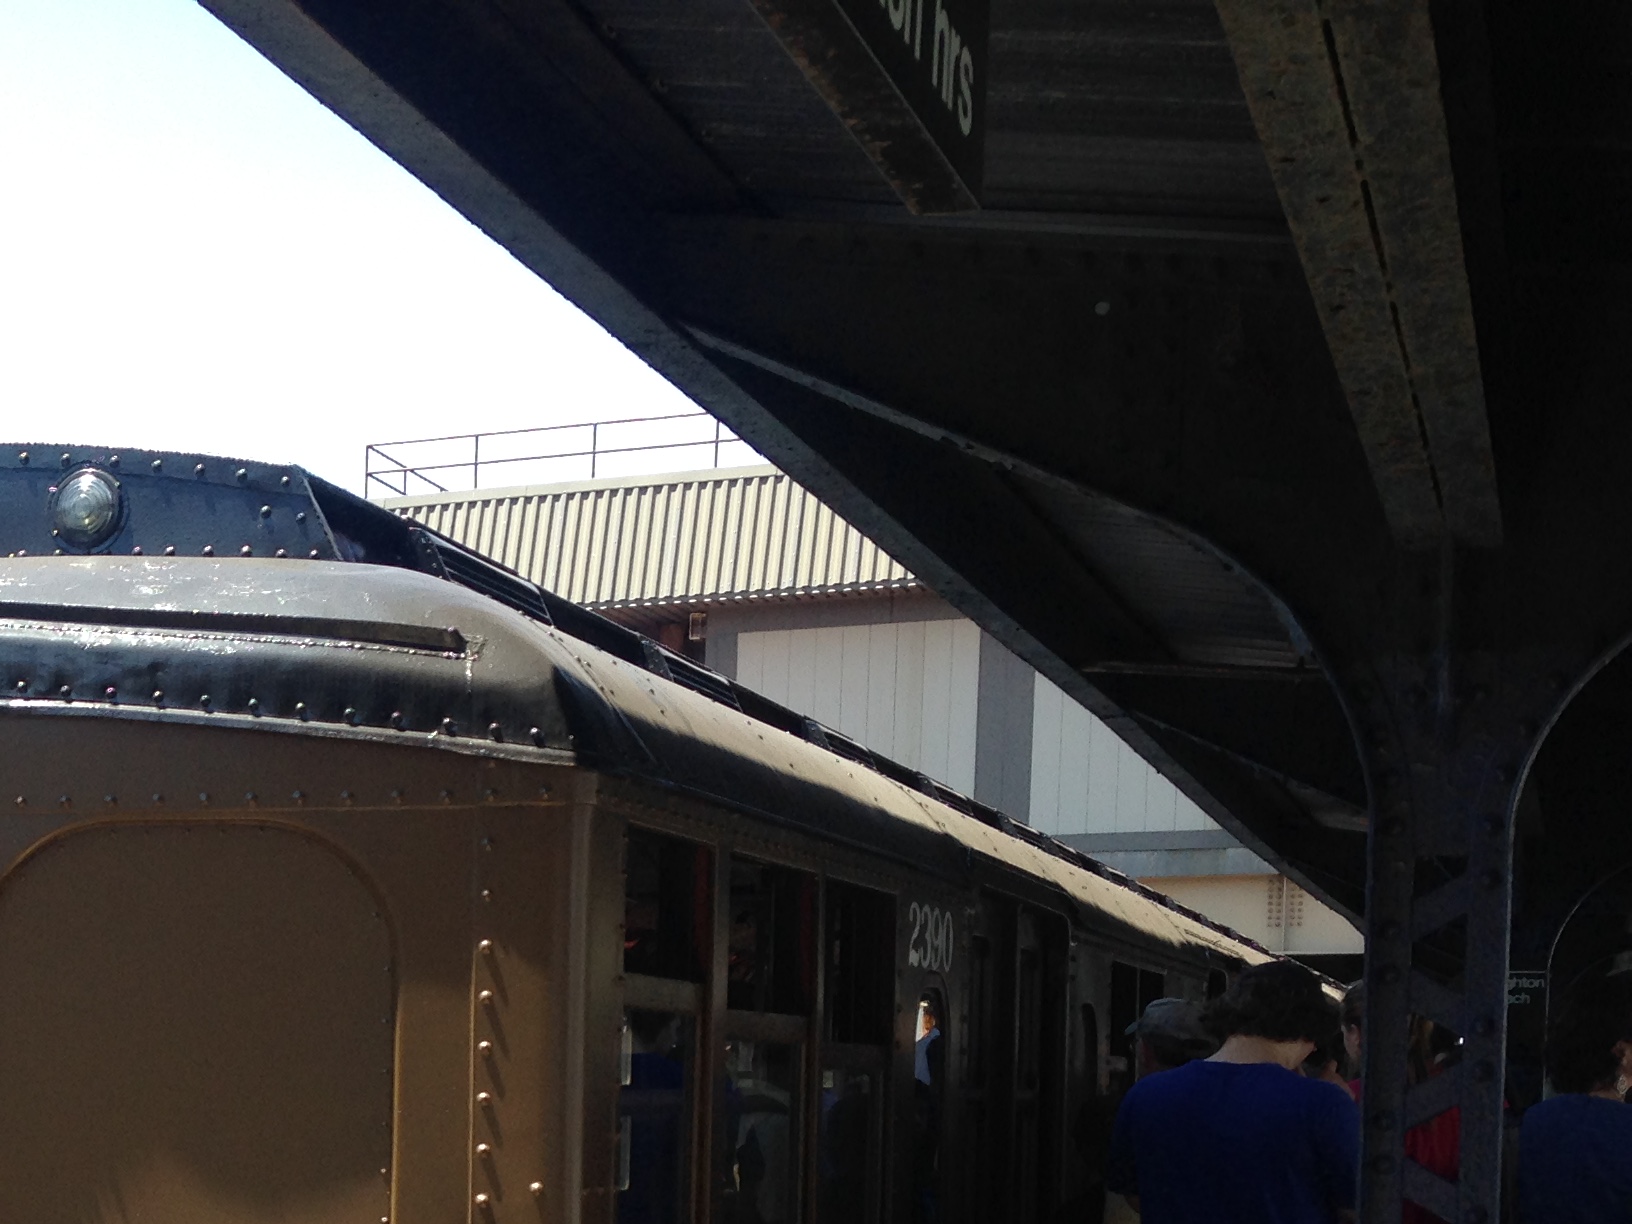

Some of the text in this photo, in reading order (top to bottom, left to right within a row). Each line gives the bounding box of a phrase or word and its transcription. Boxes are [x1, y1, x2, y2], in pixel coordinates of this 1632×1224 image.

[931, 0, 974, 137] hrs
[909, 901, 954, 972] 2390
[1507, 977, 1545, 990] ghton
